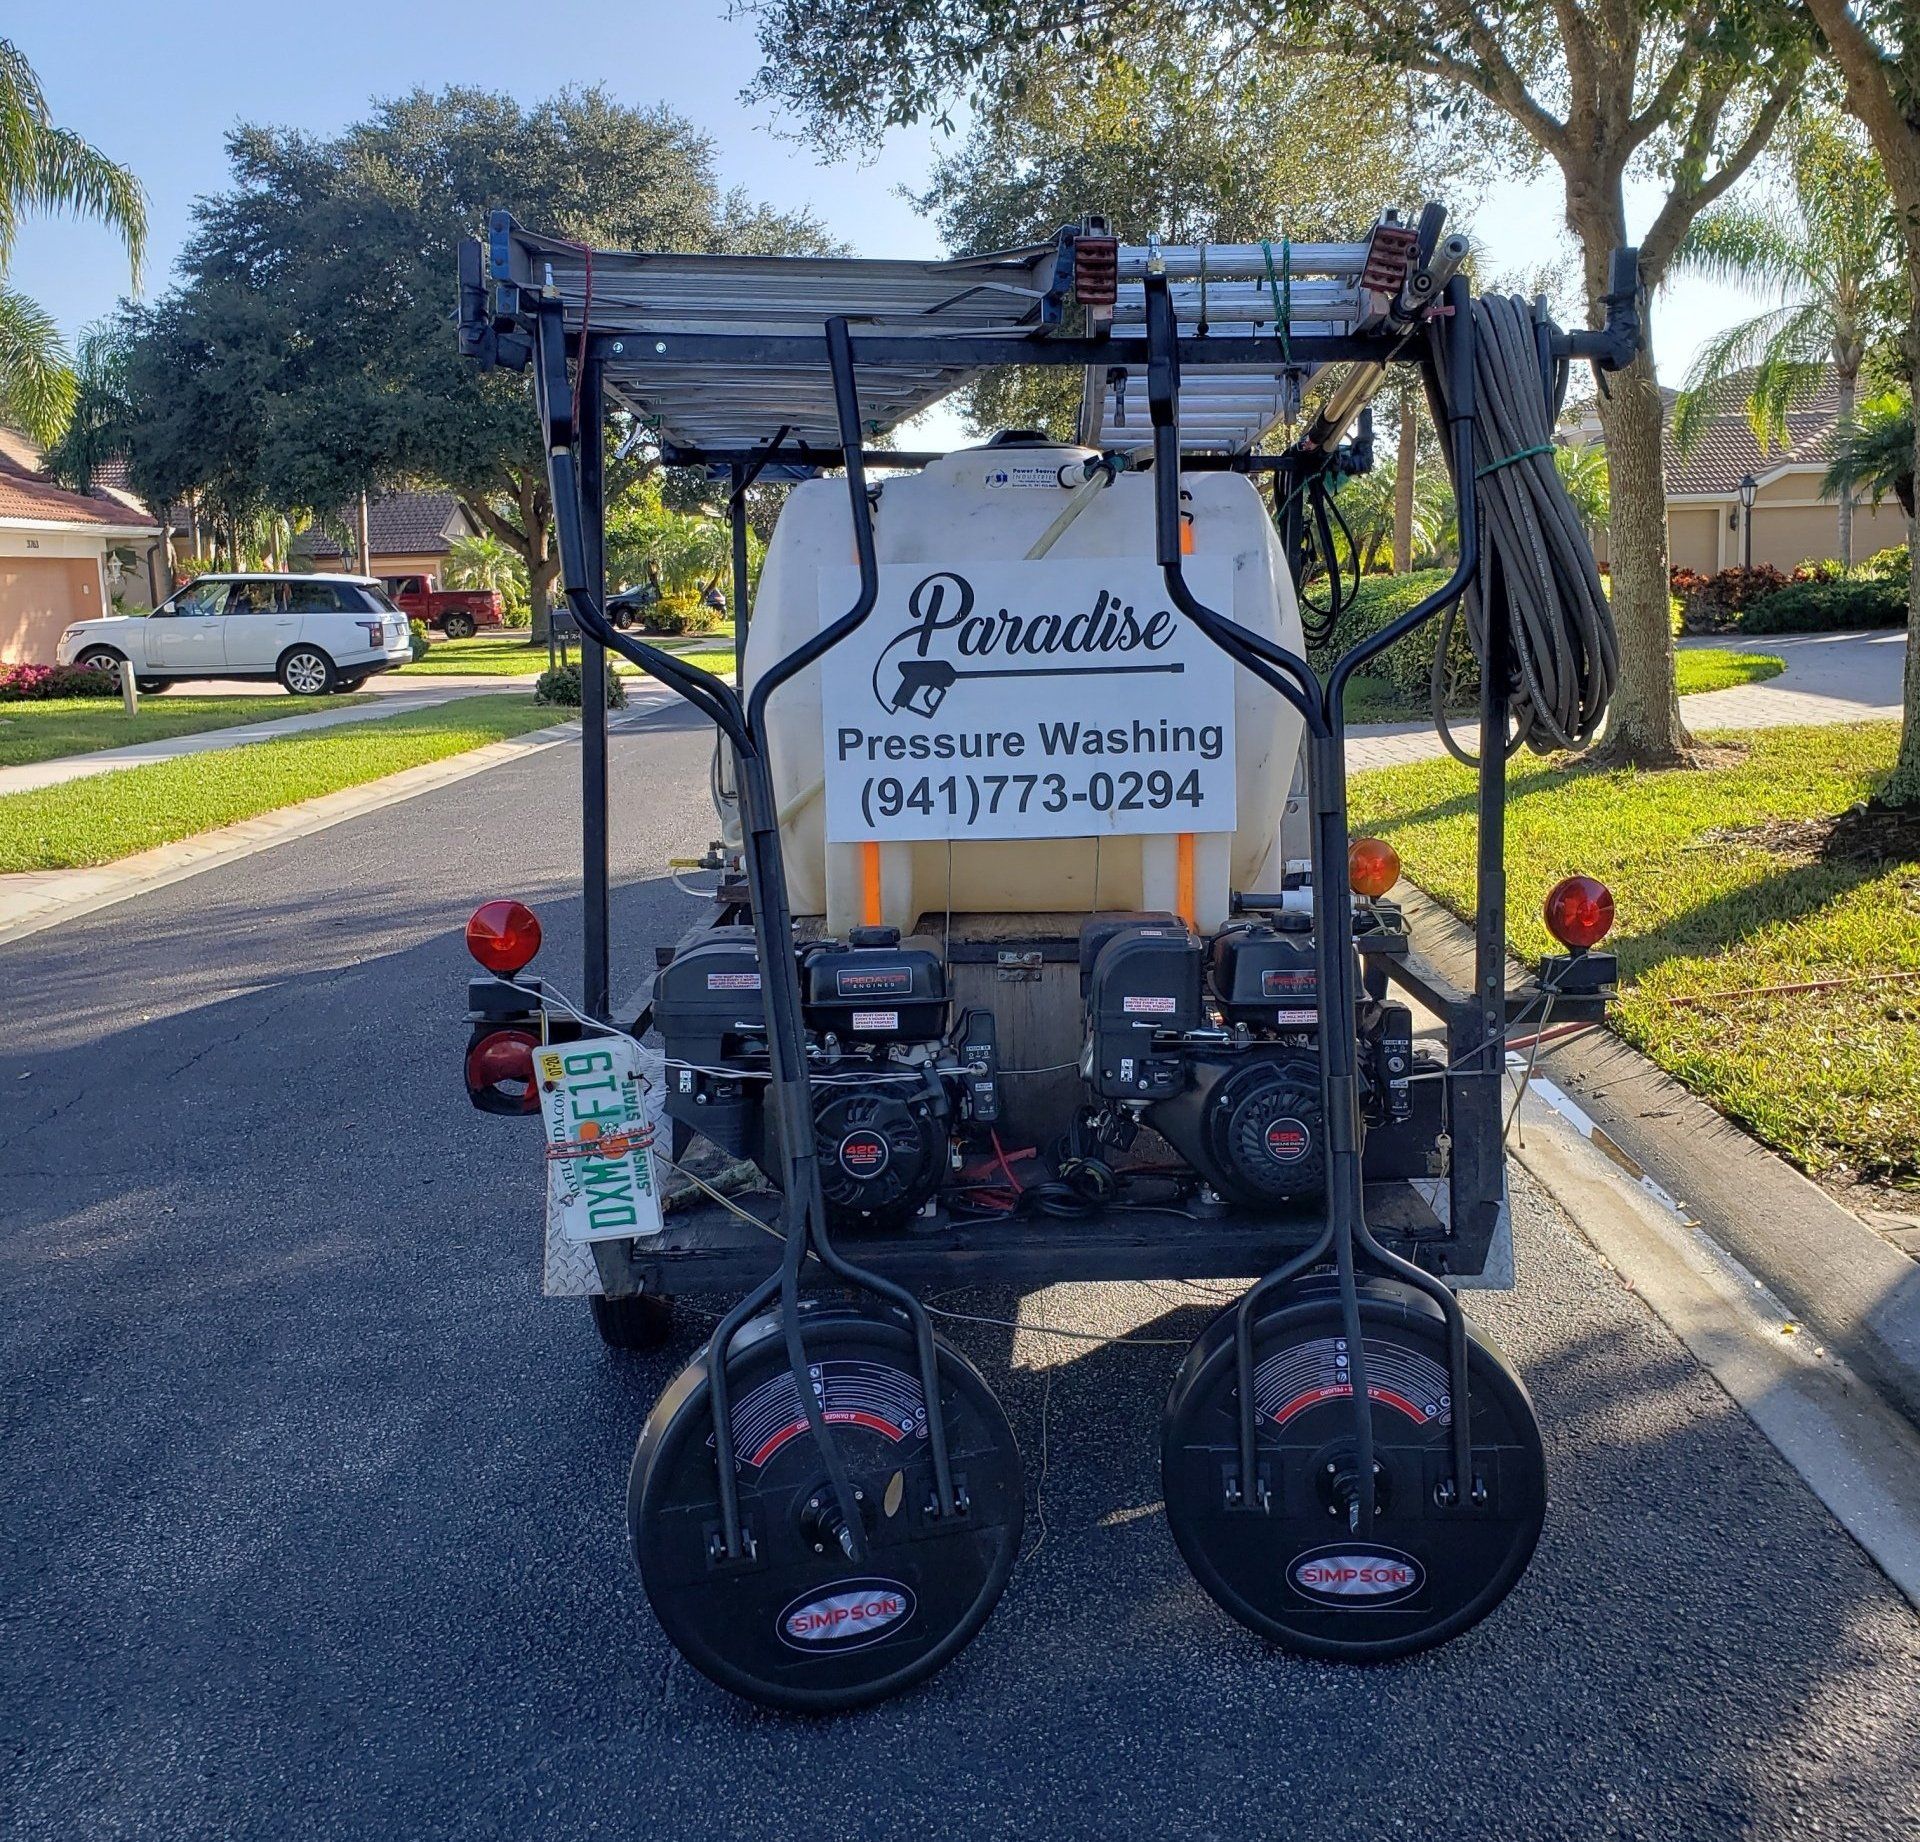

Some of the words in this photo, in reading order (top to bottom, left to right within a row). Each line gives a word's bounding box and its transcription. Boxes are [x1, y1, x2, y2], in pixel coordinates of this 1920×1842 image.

[908, 571, 1178, 657] Paradise
[837, 727, 1026, 762] Pressure
[1038, 719, 1224, 761] Washing
[861, 768, 1205, 828] (941)773-0294
[549, 1055, 563, 1077] 07-20
[565, 1051, 622, 1121] F19
[621, 1080, 642, 1122] STATE
[581, 1161, 638, 1230] DXM
[1303, 1567, 1407, 1584] SIMPSON
[793, 1598, 898, 1633] SIMPSON
